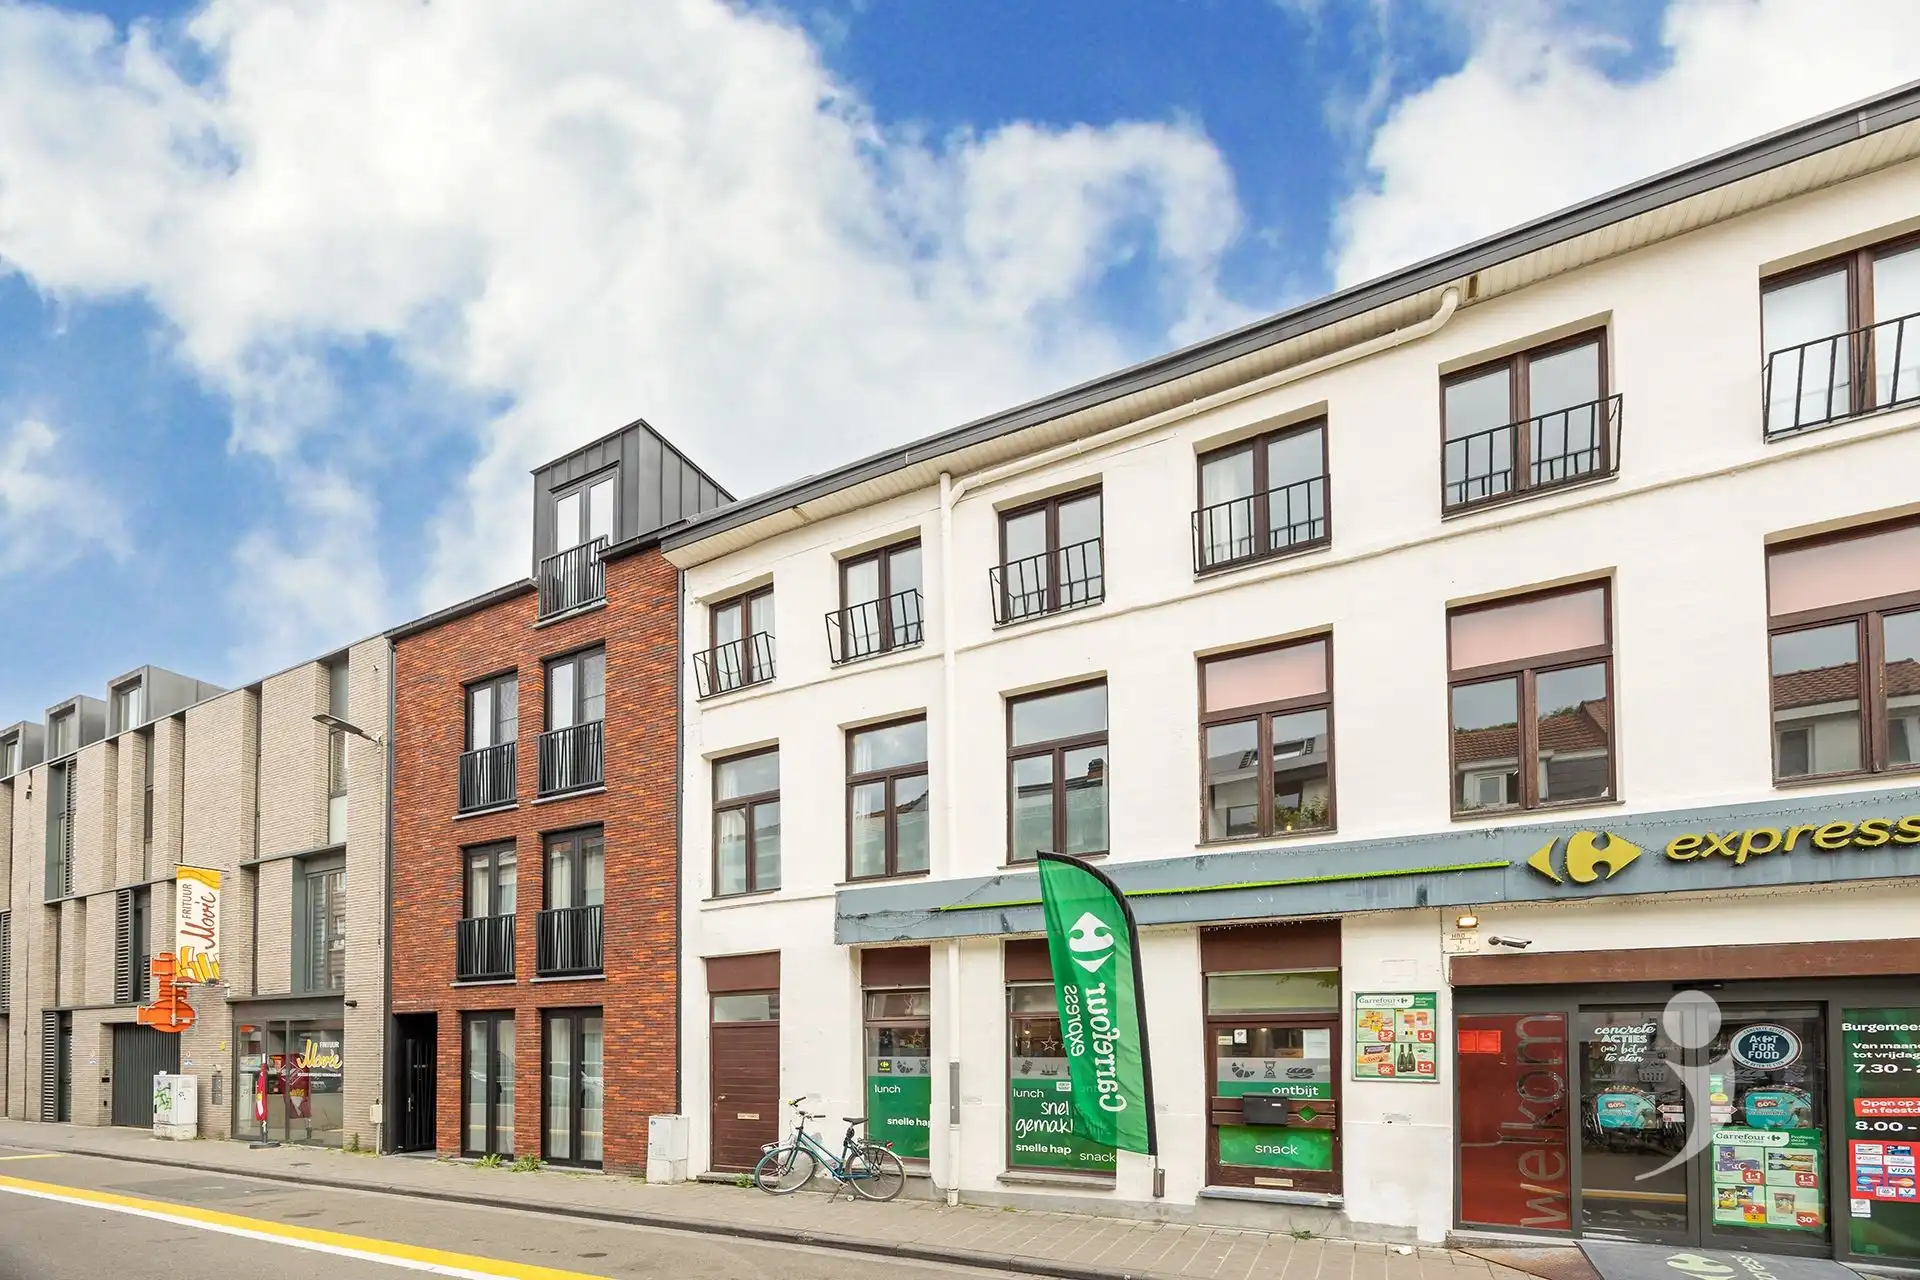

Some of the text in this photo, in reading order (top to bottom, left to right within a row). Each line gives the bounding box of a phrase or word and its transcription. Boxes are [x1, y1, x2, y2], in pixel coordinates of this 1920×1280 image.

[1664, 815, 1920, 865] express
[182, 883, 192, 920] FRITUUR
[1594, 1022, 1657, 1035] concrete
[1601, 1034, 1648, 1044] ACTIES
[1751, 1043, 1776, 1052] FOR
[1852, 1042, 1878, 1050] Van
[1747, 1050, 1780, 1060] FOOD
[1852, 1051, 1873, 1059] tot
[1853, 1063, 1899, 1074] 7.30
[874, 1084, 901, 1094] lunch
[1012, 1087, 1045, 1099] lunch
[1271, 1085, 1319, 1098] ontbijt
[1040, 1100, 1070, 1116] snel
[1860, 1099, 1896, 1108] Open
[1897, 1100, 1915, 1108] op
[887, 1117, 915, 1126] snelle
[1501, 1014, 1568, 1229] welkom
[1855, 1120, 1904, 1132] 8.00
[1715, 1132, 1766, 1142] Carrefour
[1015, 1143, 1072, 1156] snelle hap
[1254, 1143, 1299, 1156] snack
[1079, 1152, 1117, 1163] snack
